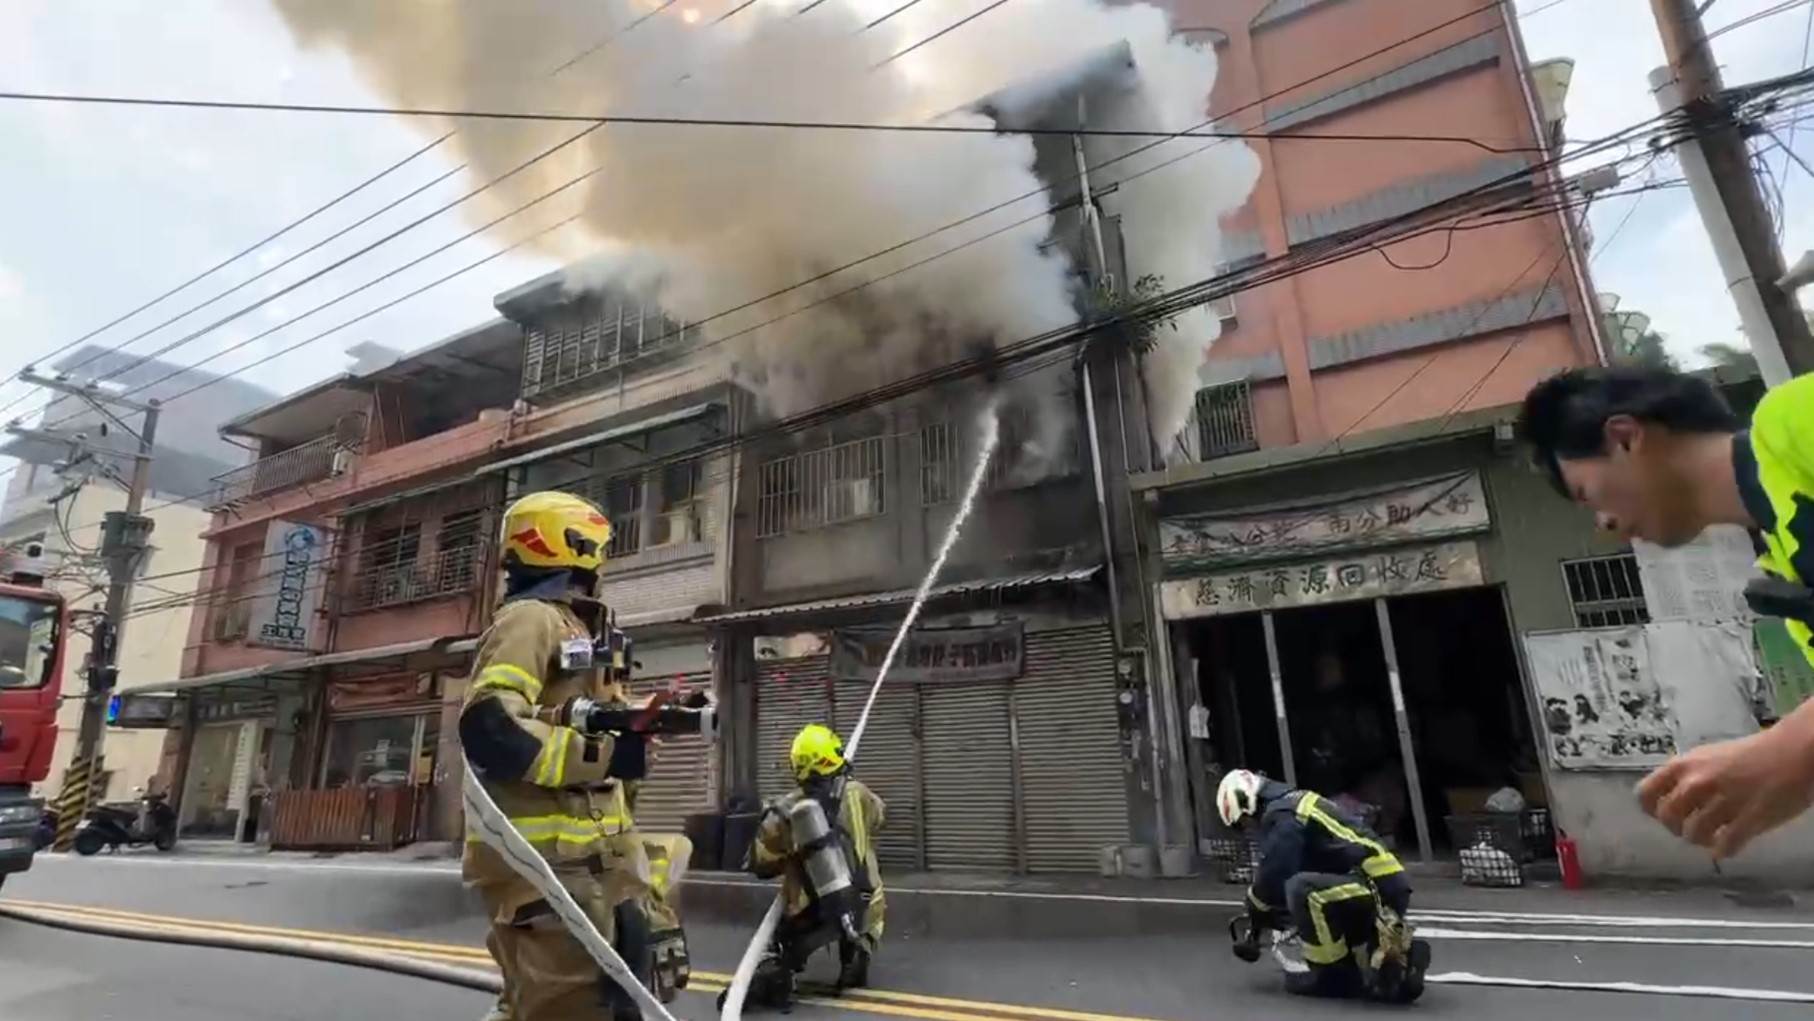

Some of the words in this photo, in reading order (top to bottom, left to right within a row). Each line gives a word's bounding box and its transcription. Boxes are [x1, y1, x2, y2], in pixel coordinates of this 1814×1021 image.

[1195, 552, 1449, 606] 慈濟資源回收處
